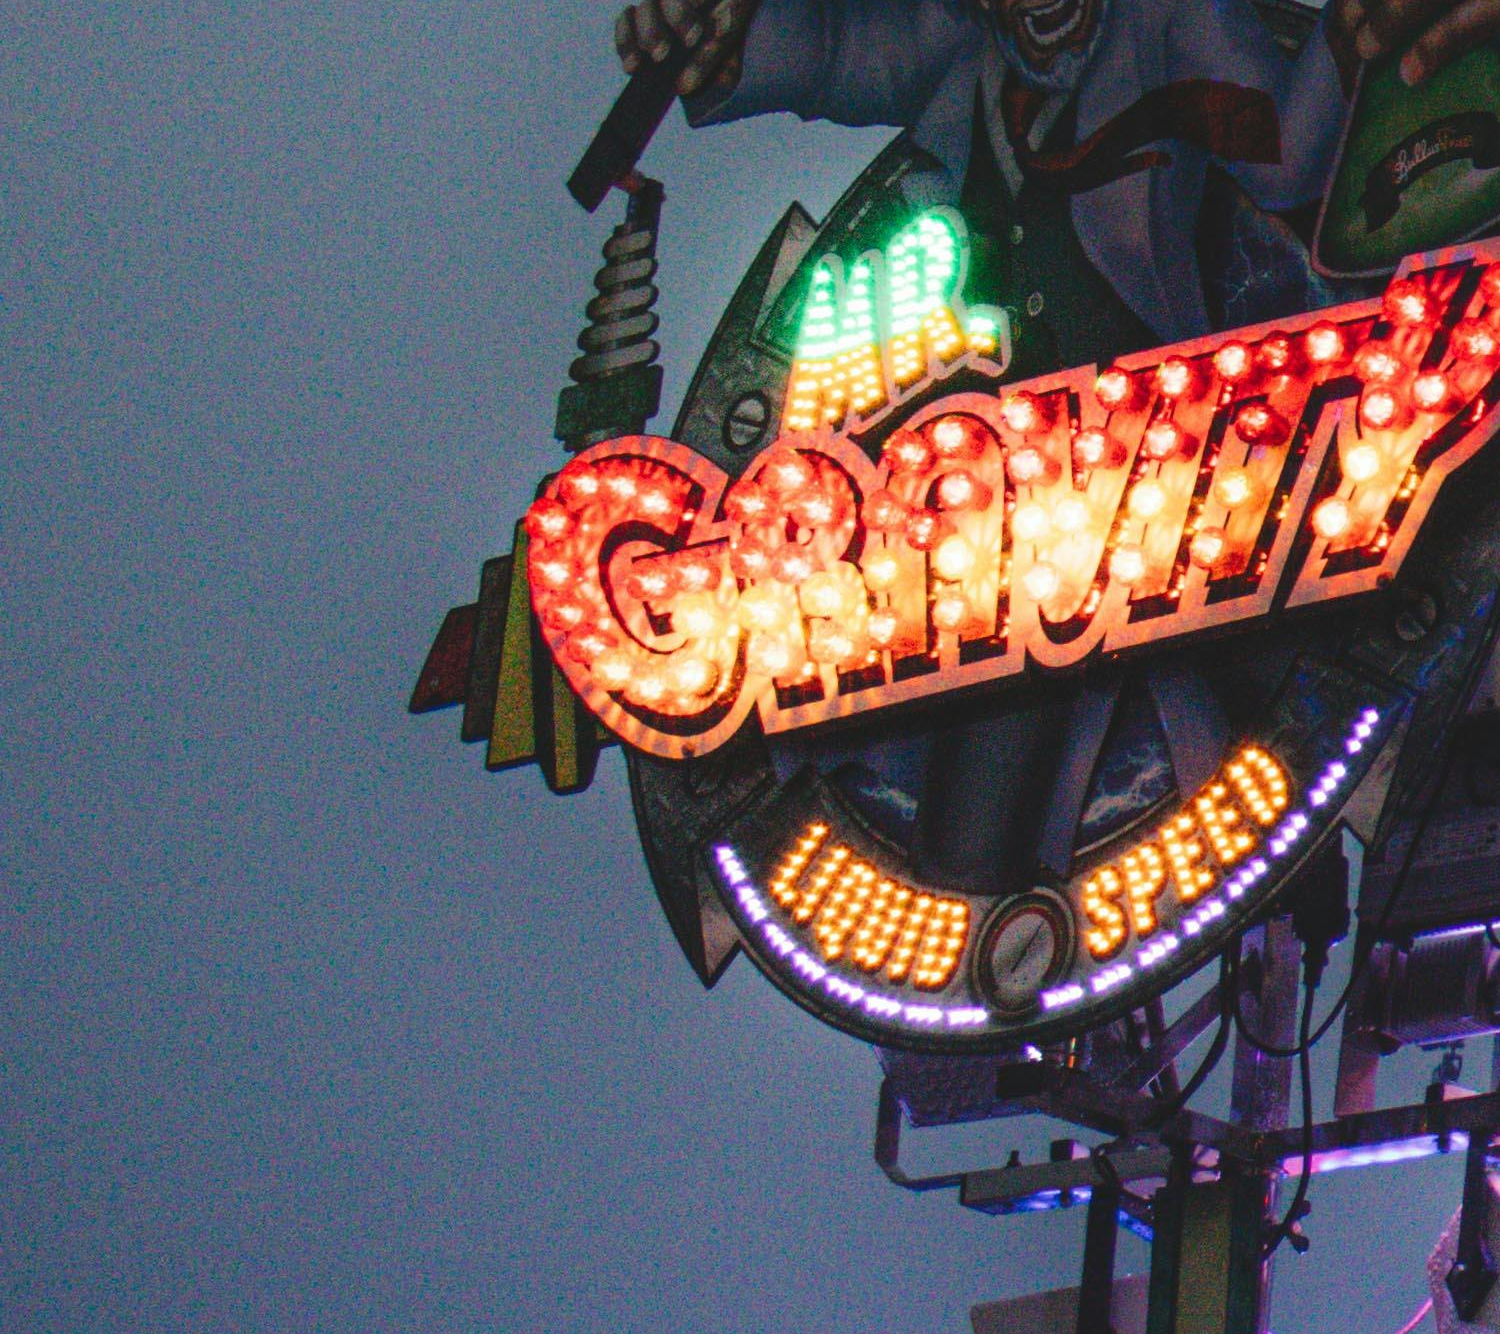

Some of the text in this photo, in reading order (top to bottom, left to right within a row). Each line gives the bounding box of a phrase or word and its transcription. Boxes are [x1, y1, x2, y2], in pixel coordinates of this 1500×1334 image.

[784, 209, 1010, 435] MR.
[769, 741, 1290, 990] LIQUID SPEED
